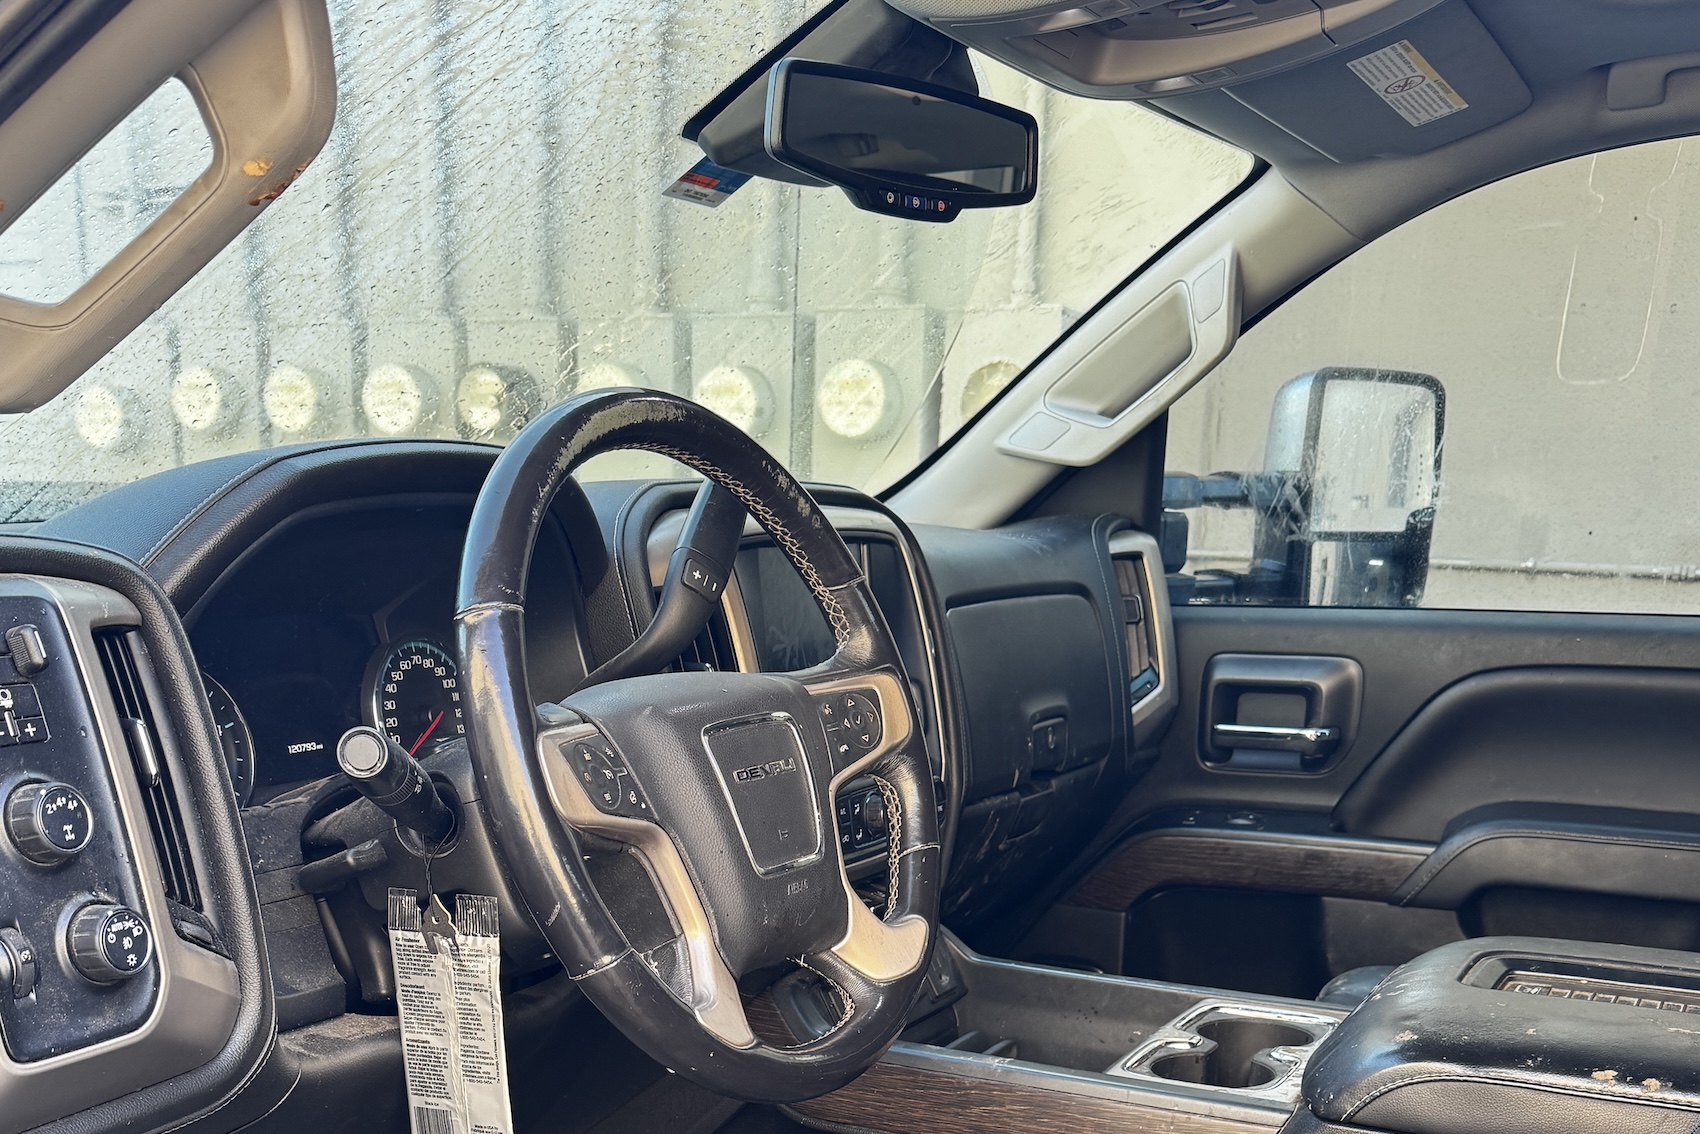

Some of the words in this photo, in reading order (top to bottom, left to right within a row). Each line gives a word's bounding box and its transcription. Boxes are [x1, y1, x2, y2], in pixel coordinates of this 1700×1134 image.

[400, 660, 411, 670] 60
[411, 655, 422, 665] 70
[423, 658, 434, 668] 80
[391, 671, 404, 681] 50
[434, 666, 446, 676] 90
[385, 683, 397, 693] 40
[442, 678, 456, 689] 100
[384, 700, 396, 710] 30
[386, 717, 398, 727] 20
[457, 724, 465, 734] 13
[733, 757, 797, 784] DENALI
